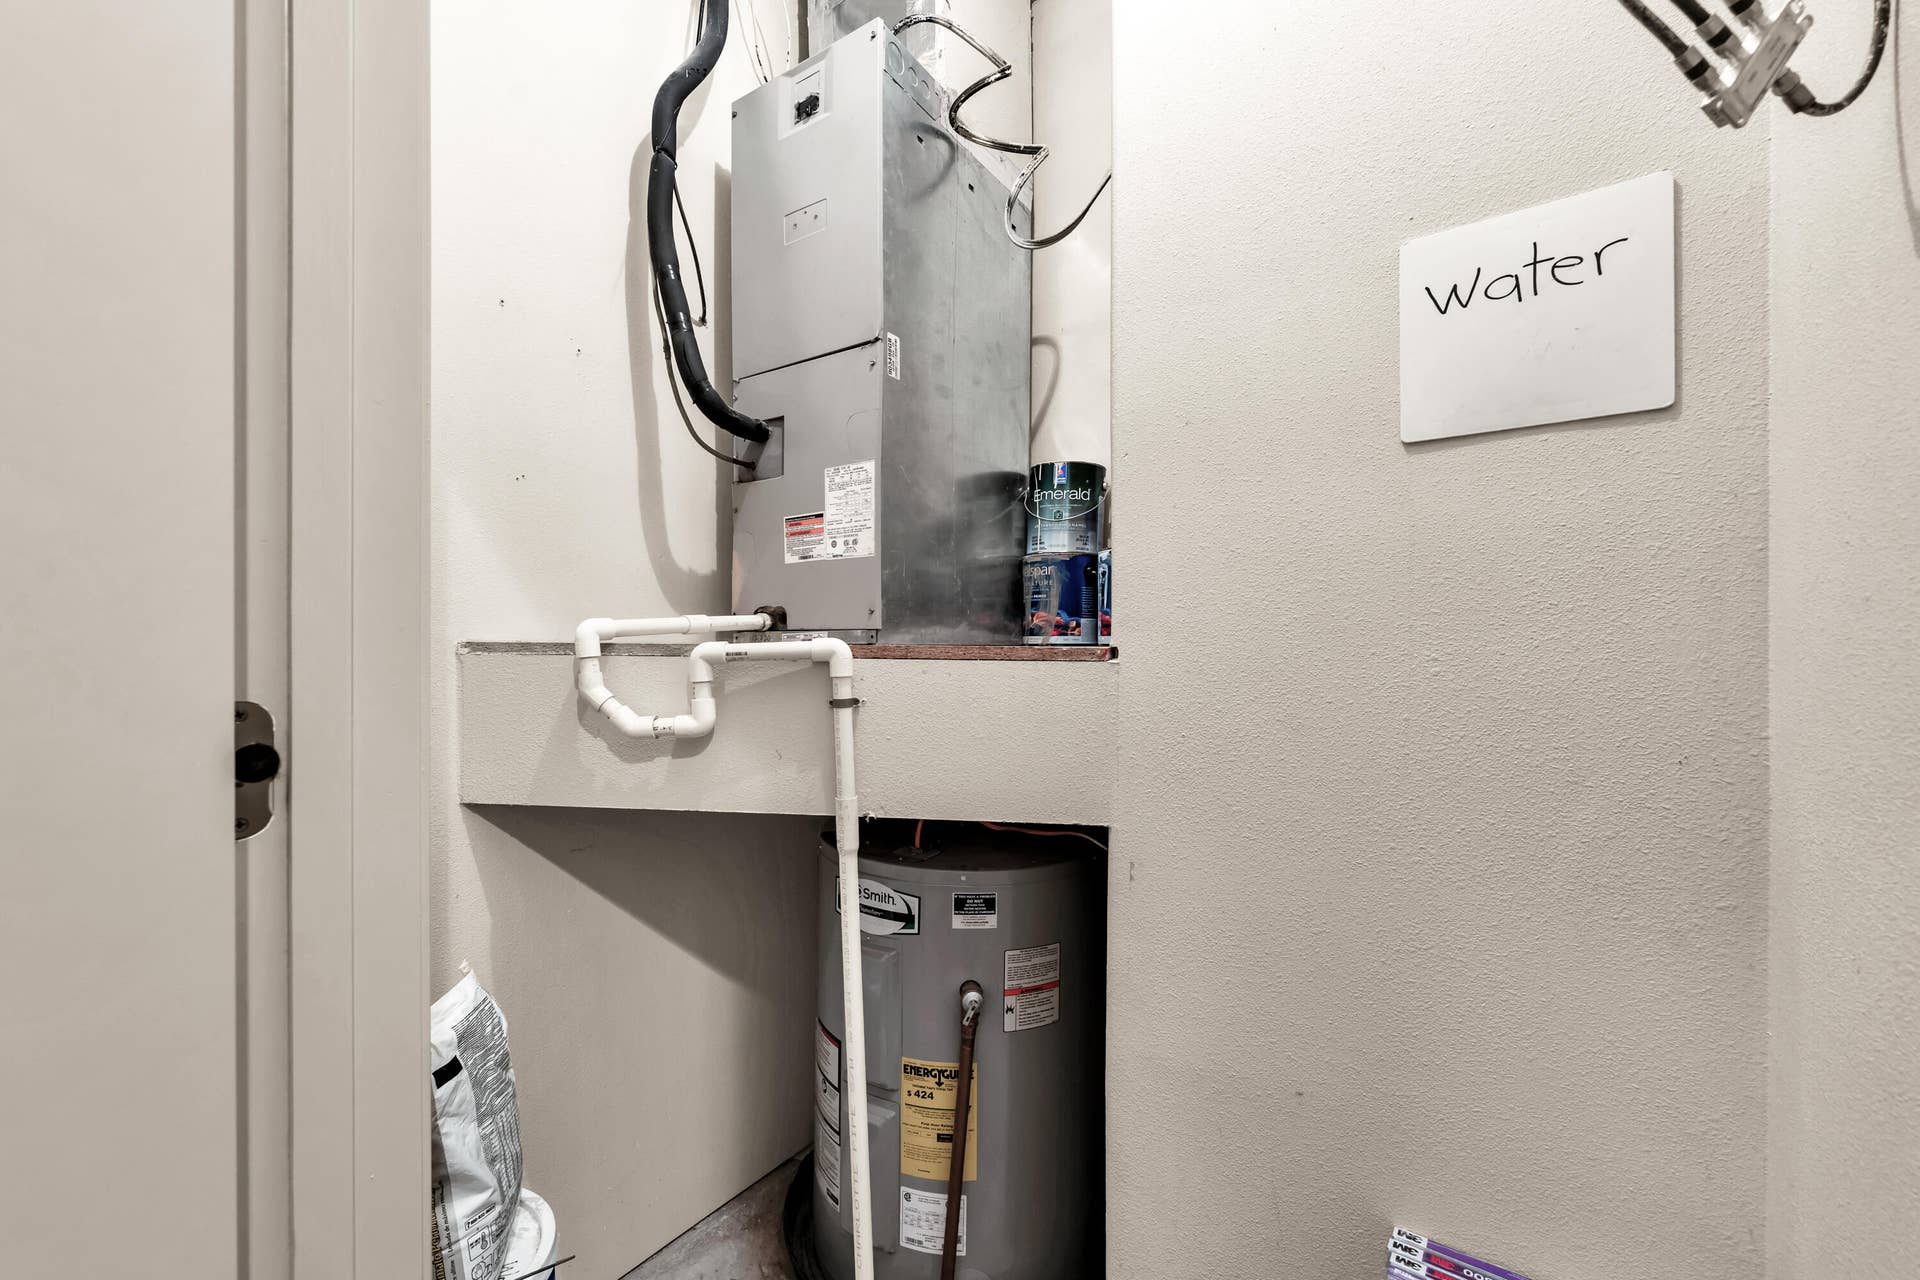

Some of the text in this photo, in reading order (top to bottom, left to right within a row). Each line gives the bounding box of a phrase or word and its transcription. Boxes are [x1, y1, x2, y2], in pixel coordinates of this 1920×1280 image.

[1033, 488, 1091, 502] Emerald
[903, 1063, 974, 1083] ENERGYGUI
[914, 1089, 934, 1100] 424
[853, 1167, 863, 1270] CHARLOTTE
[1392, 1241, 1419, 1257] 3M
[1395, 1255, 1422, 1272] 3M
